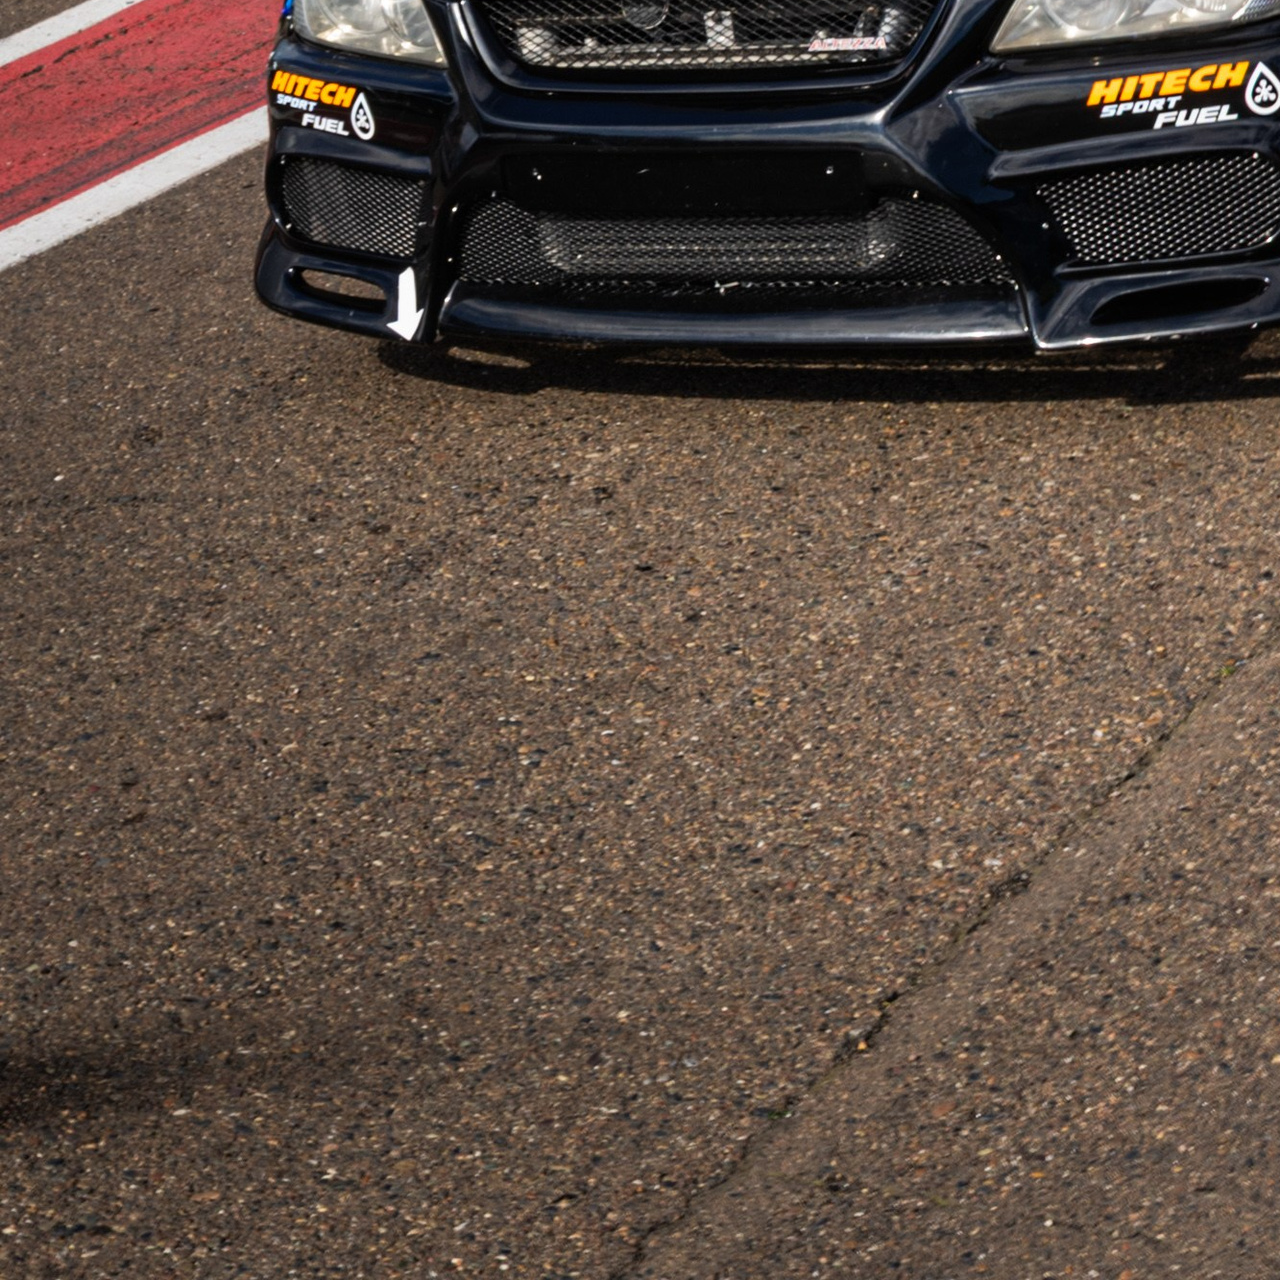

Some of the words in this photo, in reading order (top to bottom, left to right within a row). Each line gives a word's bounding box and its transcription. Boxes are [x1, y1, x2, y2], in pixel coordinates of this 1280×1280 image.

[808, 37, 887, 52] ALTEZZA
[271, 70, 357, 108] HITECH
[1086, 60, 1250, 106] HITECH
[276, 93, 318, 112] SPORT
[1099, 95, 1182, 118] SPORT
[301, 113, 350, 136] FUEL
[1153, 104, 1239, 130] FUEL
